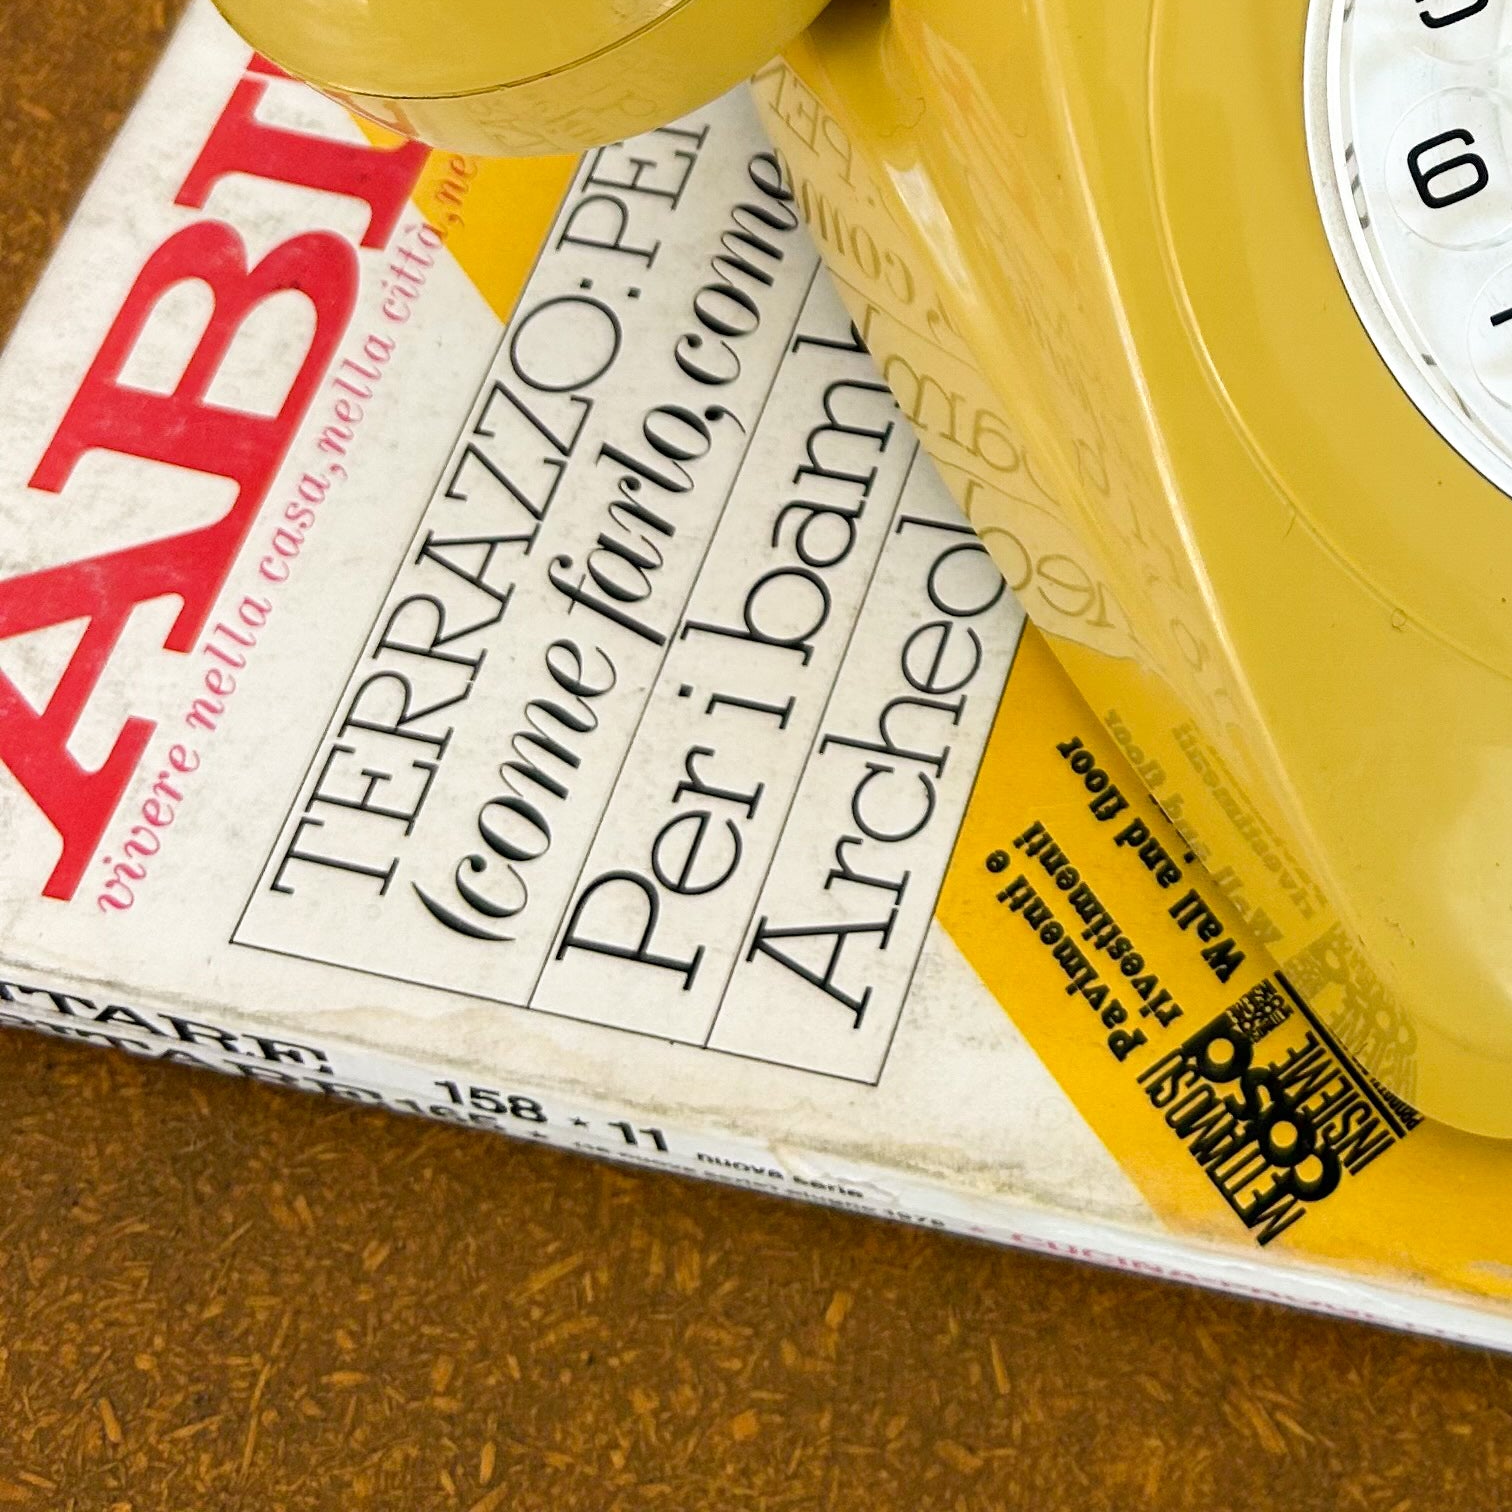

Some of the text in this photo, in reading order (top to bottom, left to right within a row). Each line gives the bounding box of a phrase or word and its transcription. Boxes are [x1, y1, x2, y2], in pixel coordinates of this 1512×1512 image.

[1405, 128, 1490, 211] 6
[0, 51, 433, 901] ABI
[270, 276, 641, 897] TERRAZZO:
[97, 743, 200, 913] vivere
[186, 596, 274, 733] nella
[411, 637, 618, 941] (come
[555, 746, 765, 991] Per
[679, 684, 797, 731] i
[1056, 736, 1129, 821] floor
[1113, 817, 1182, 888] and
[985, 849, 1148, 1062] Pavimenti e
[1013, 820, 1184, 1028] rivestimenti
[1168, 888, 1245, 983] Wall
[434, 1079, 549, 1124] 158
[608, 1120, 669, 1152] 11
[1182, 1012, 1341, 1202] casa
[1268, 1031, 1396, 1176] INSIEME
